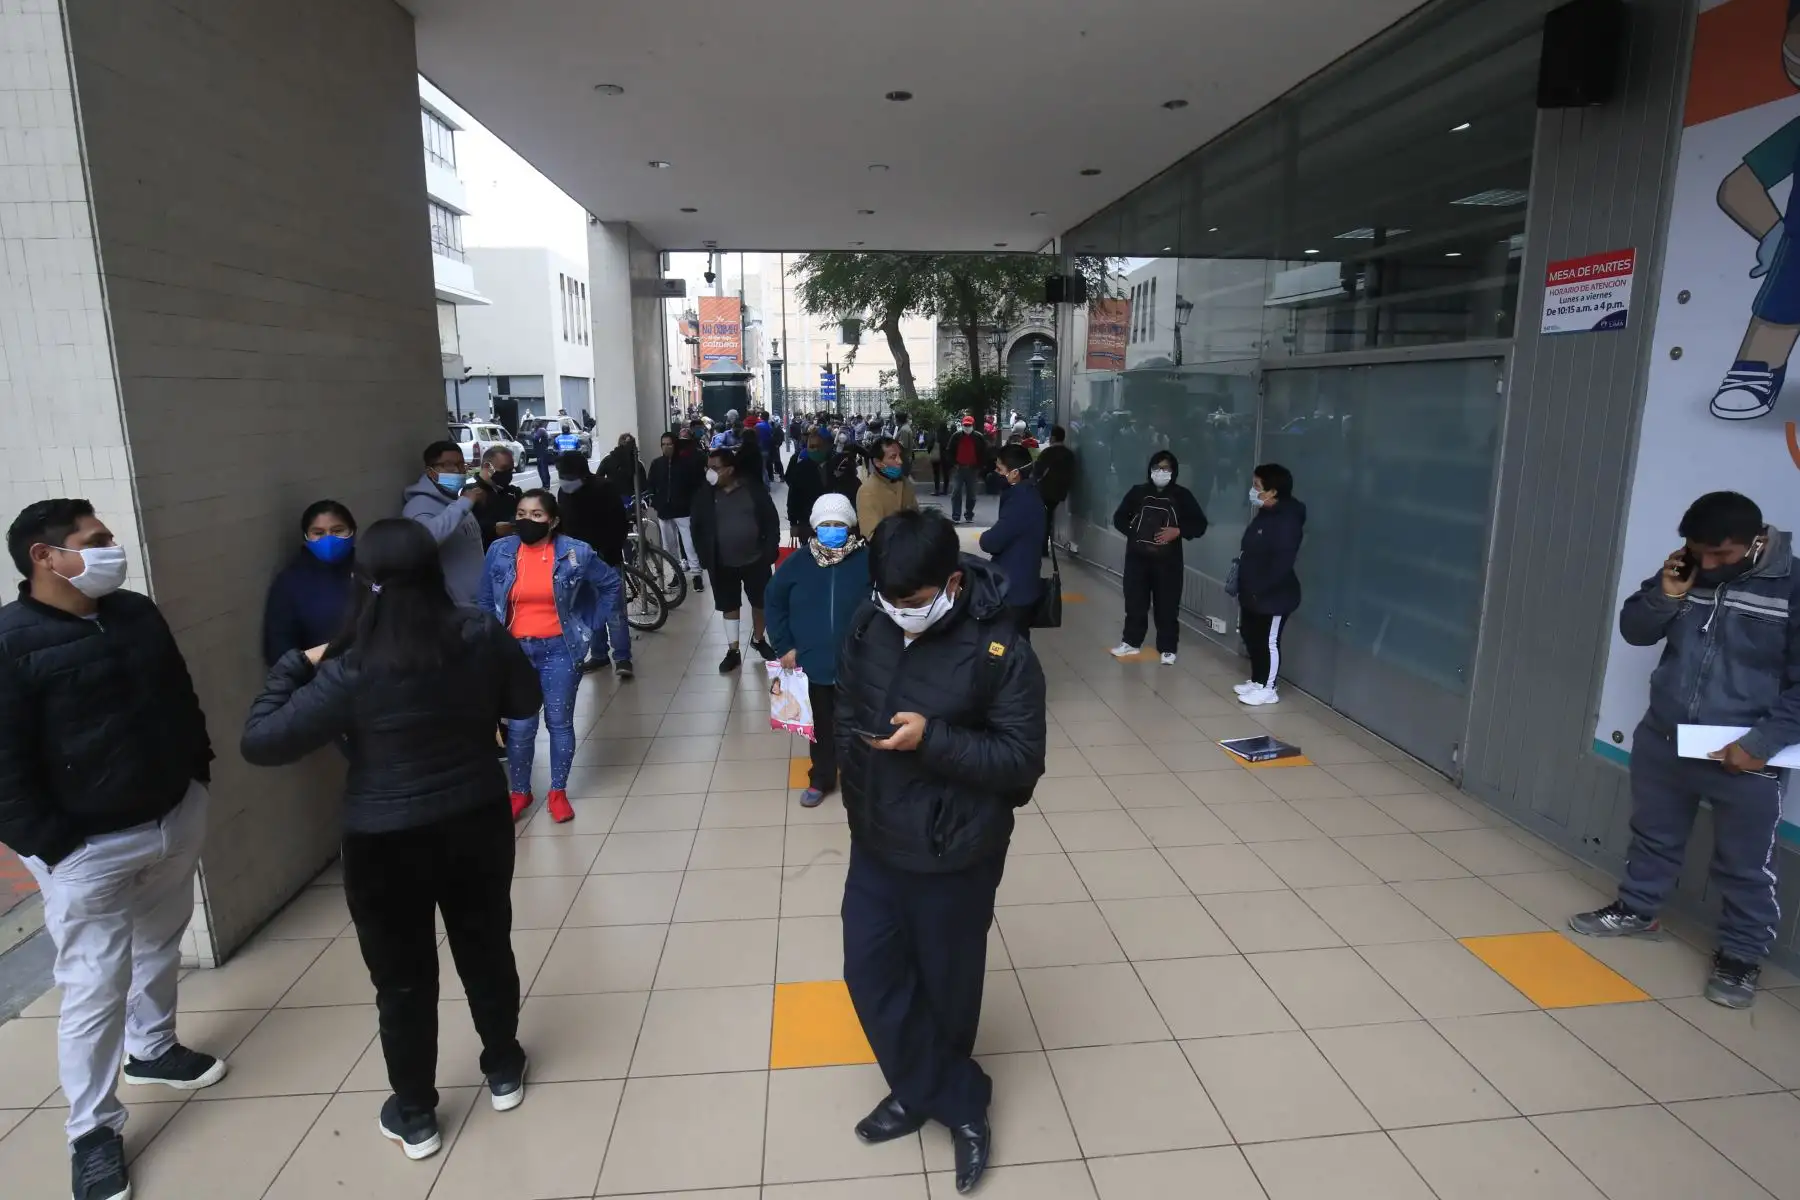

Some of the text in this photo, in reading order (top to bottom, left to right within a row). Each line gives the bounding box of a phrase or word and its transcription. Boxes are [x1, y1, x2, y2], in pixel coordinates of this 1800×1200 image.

[1549, 259, 1632, 282] MESA DE PARTES
[1549, 286, 1580, 296] HORARIO
[1580, 284, 1590, 292] DE
[1559, 295, 1579, 304] Lunes
[1586, 291, 1612, 300] viernes
[1546, 308, 1556, 316] De
[1558, 305, 1575, 315] 10:15
[1600, 301, 1605, 309] 4
[1606, 301, 1625, 311] p.m.
